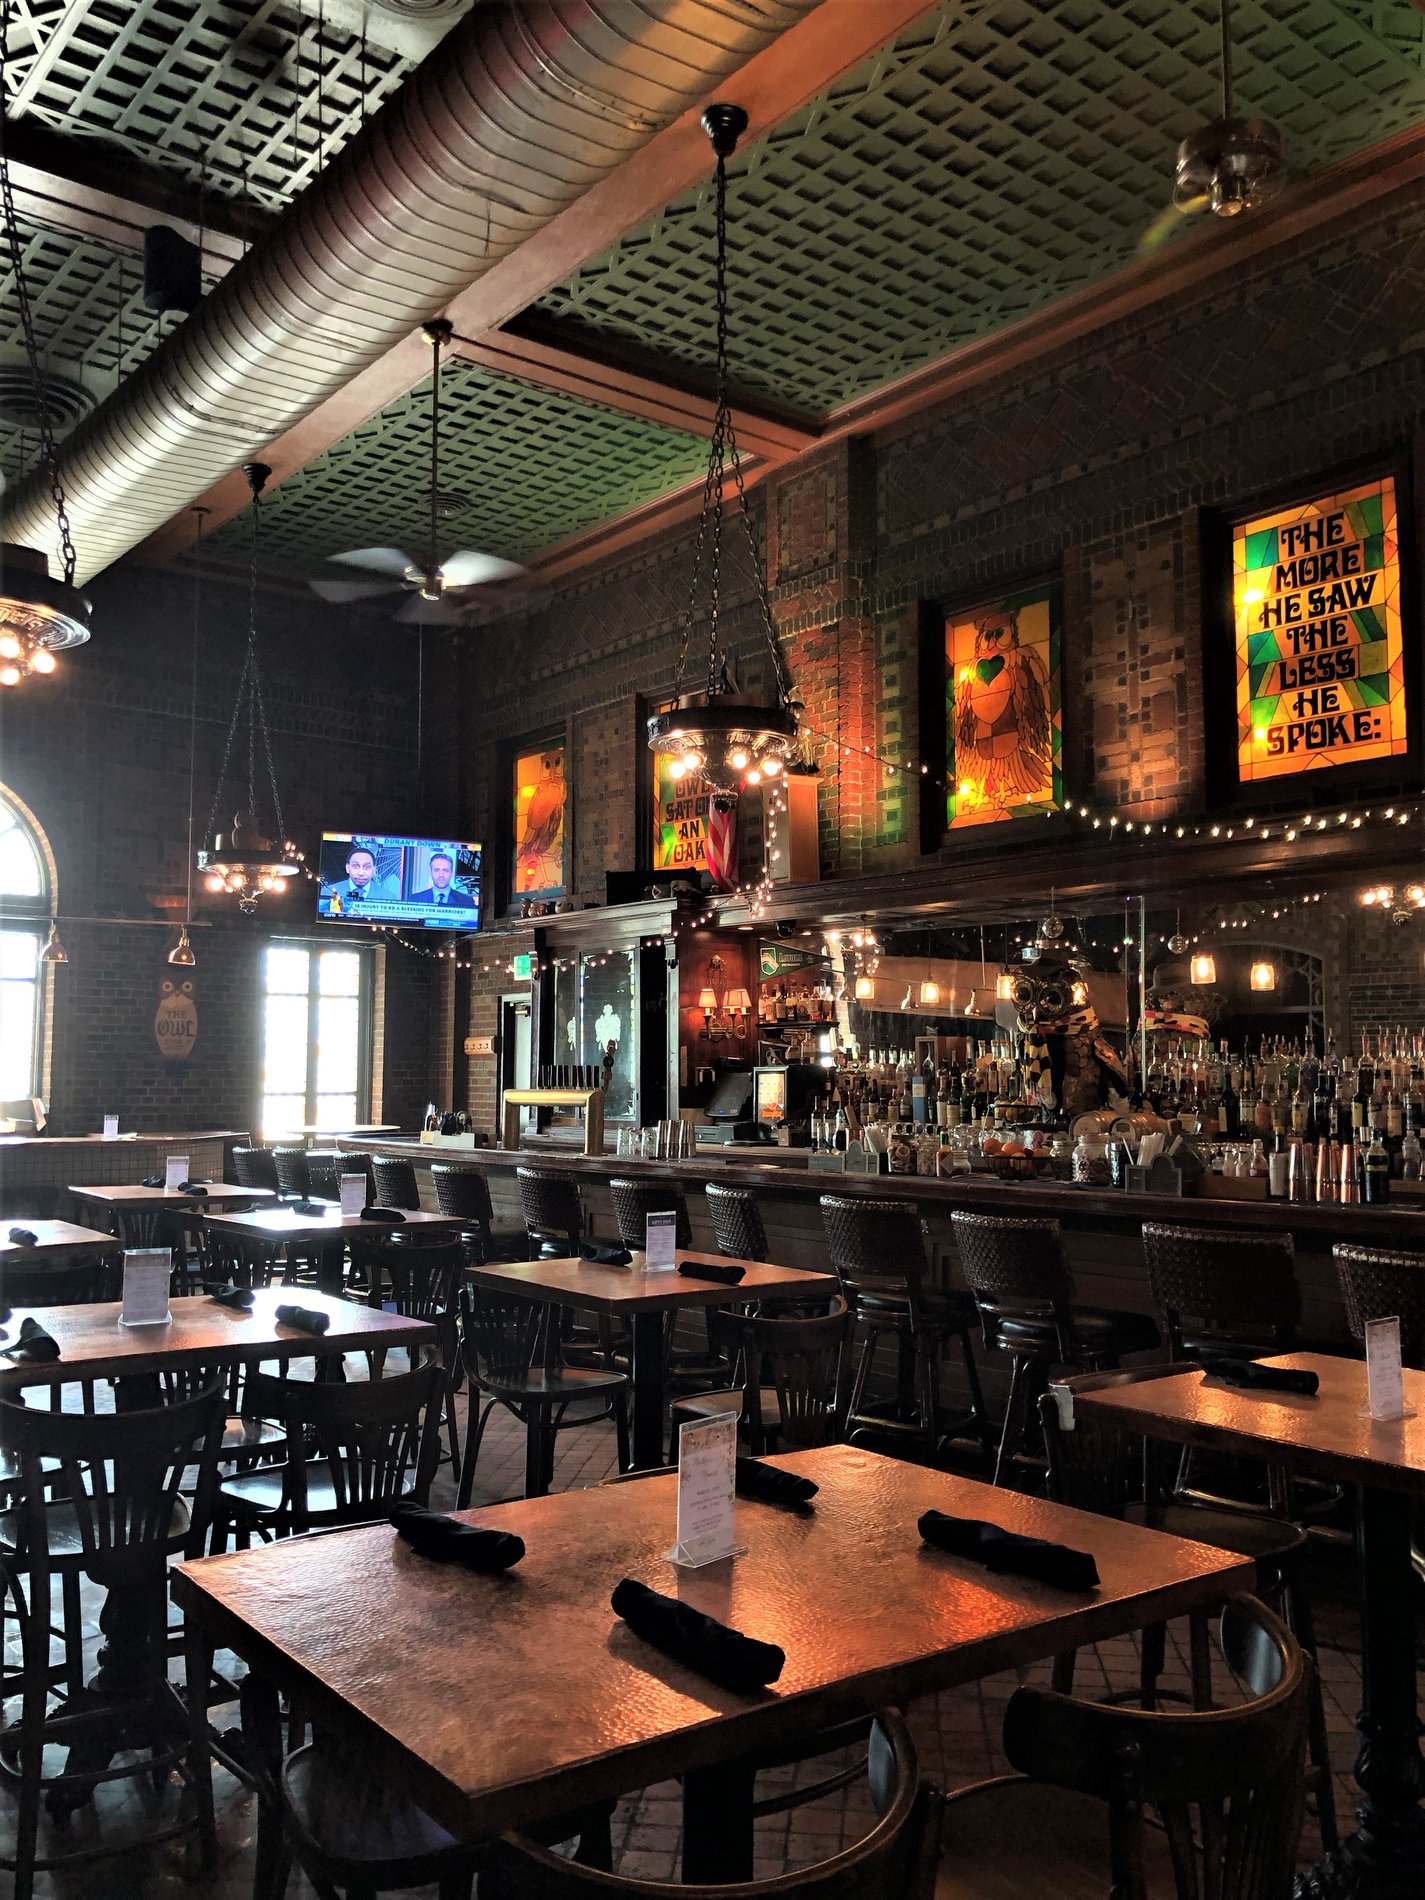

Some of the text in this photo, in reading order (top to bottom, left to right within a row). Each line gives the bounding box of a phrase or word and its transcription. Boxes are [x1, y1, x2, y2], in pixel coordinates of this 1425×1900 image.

[1281, 512, 1344, 557] THE
[1274, 543, 1360, 593] MORE
[1259, 573, 1379, 629] HE SAW
[1286, 615, 1349, 655] THE
[1279, 649, 1356, 691] LESS
[1293, 685, 1340, 718] HE
[1266, 710, 1382, 756] SPOKE:
[665, 801, 692, 822] SAT
[384, 838, 441, 848] DURANT DOWN
[678, 820, 700, 839] AN
[674, 840, 706, 863] OAK
[157, 1020, 195, 1037] OWL
[166, 1010, 186, 1019] THE
